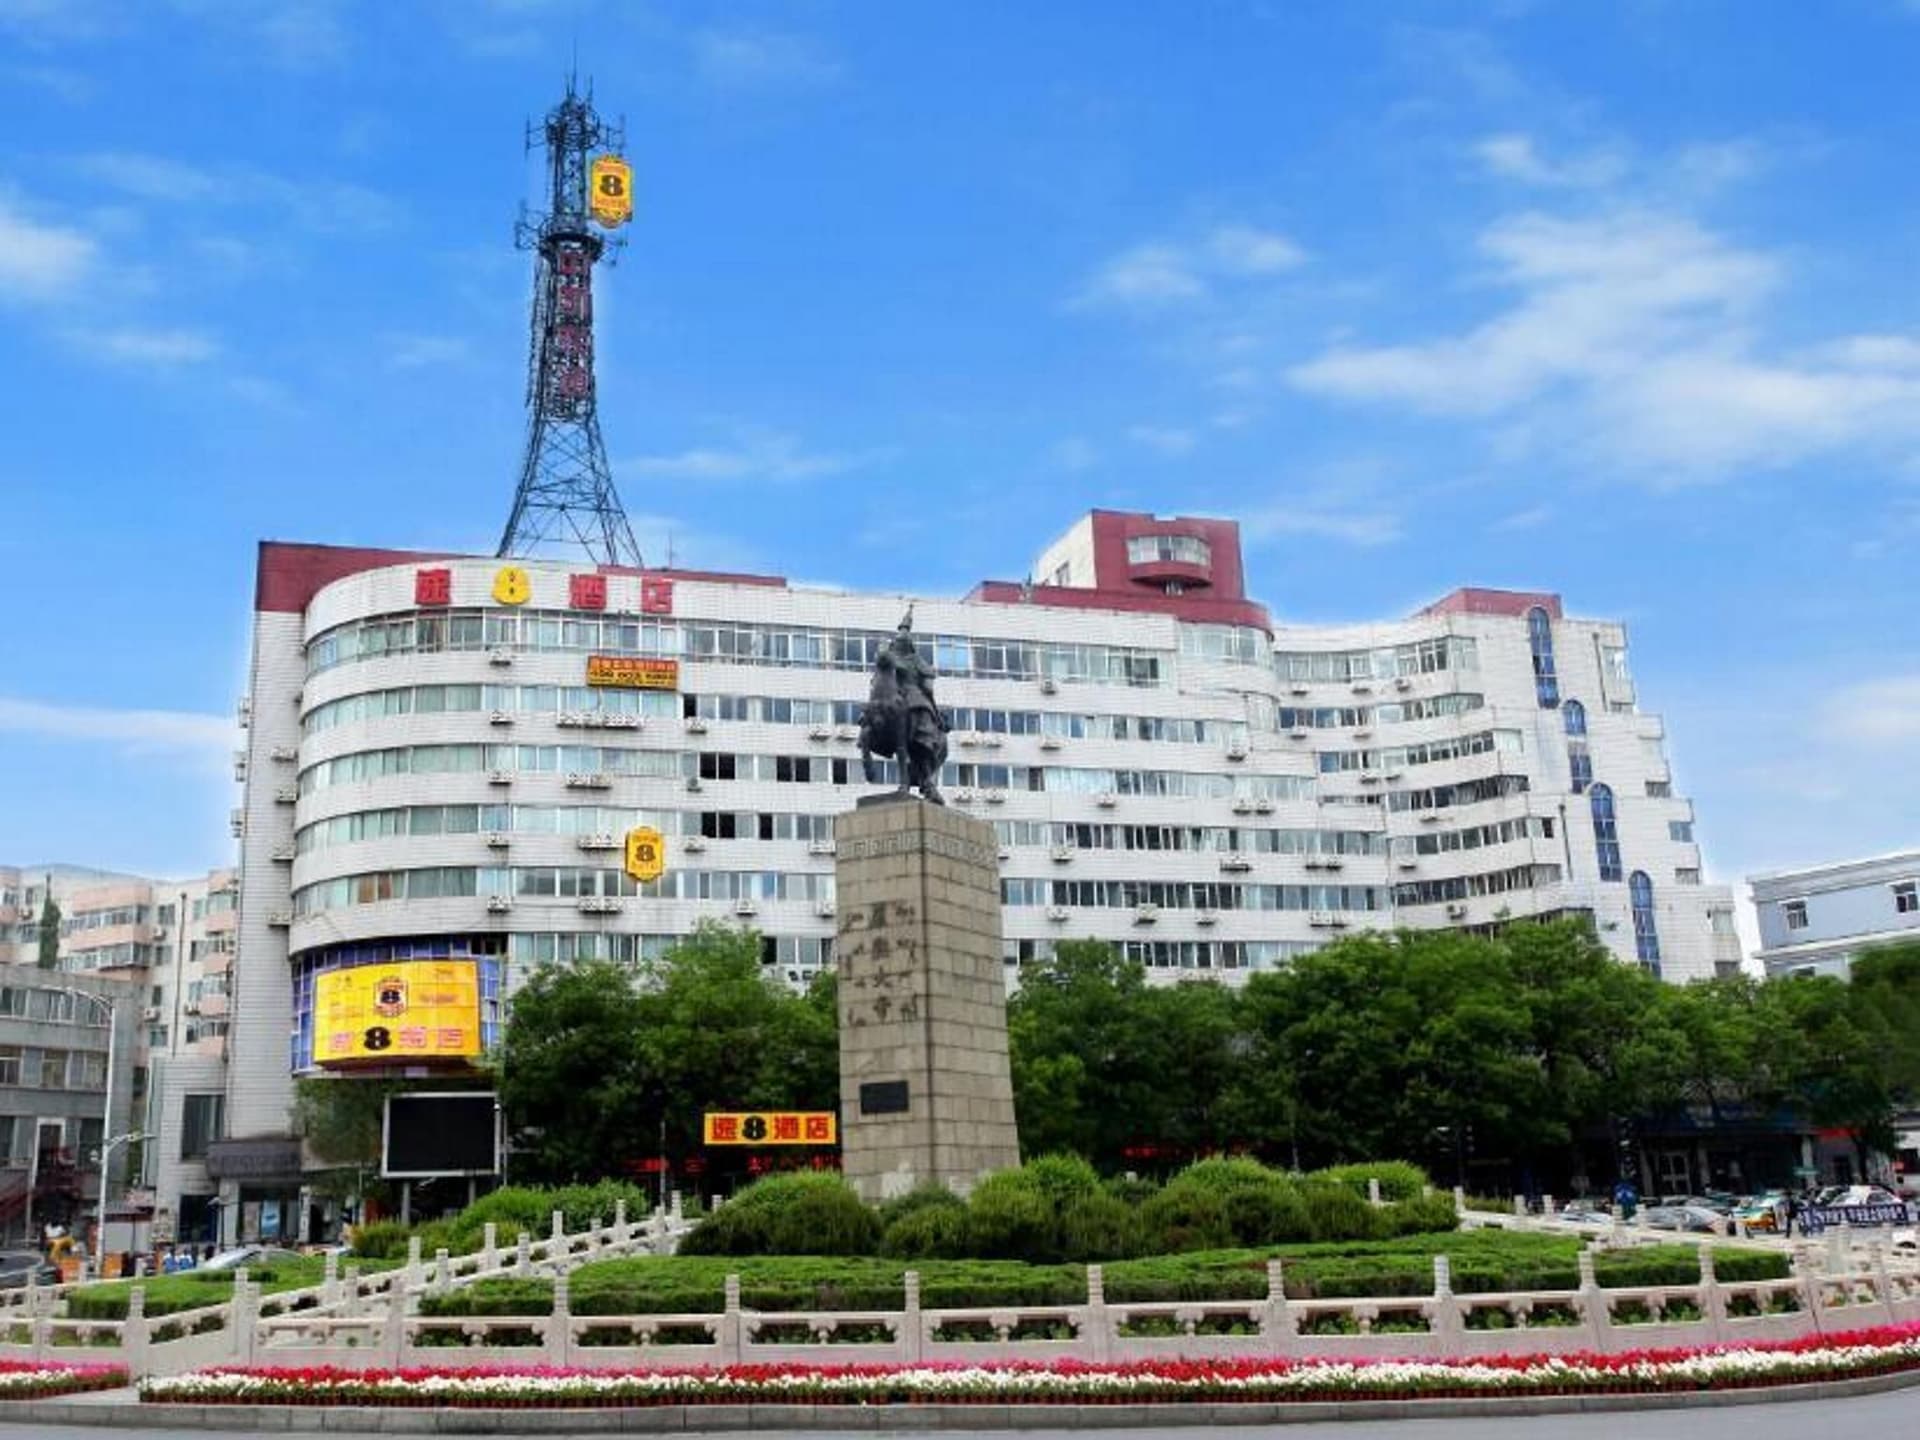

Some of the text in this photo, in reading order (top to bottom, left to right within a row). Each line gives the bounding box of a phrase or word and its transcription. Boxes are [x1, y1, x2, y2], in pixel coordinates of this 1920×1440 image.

[599, 174, 624, 197] 8
[636, 844, 656, 862] 8
[380, 989, 400, 1004] 8
